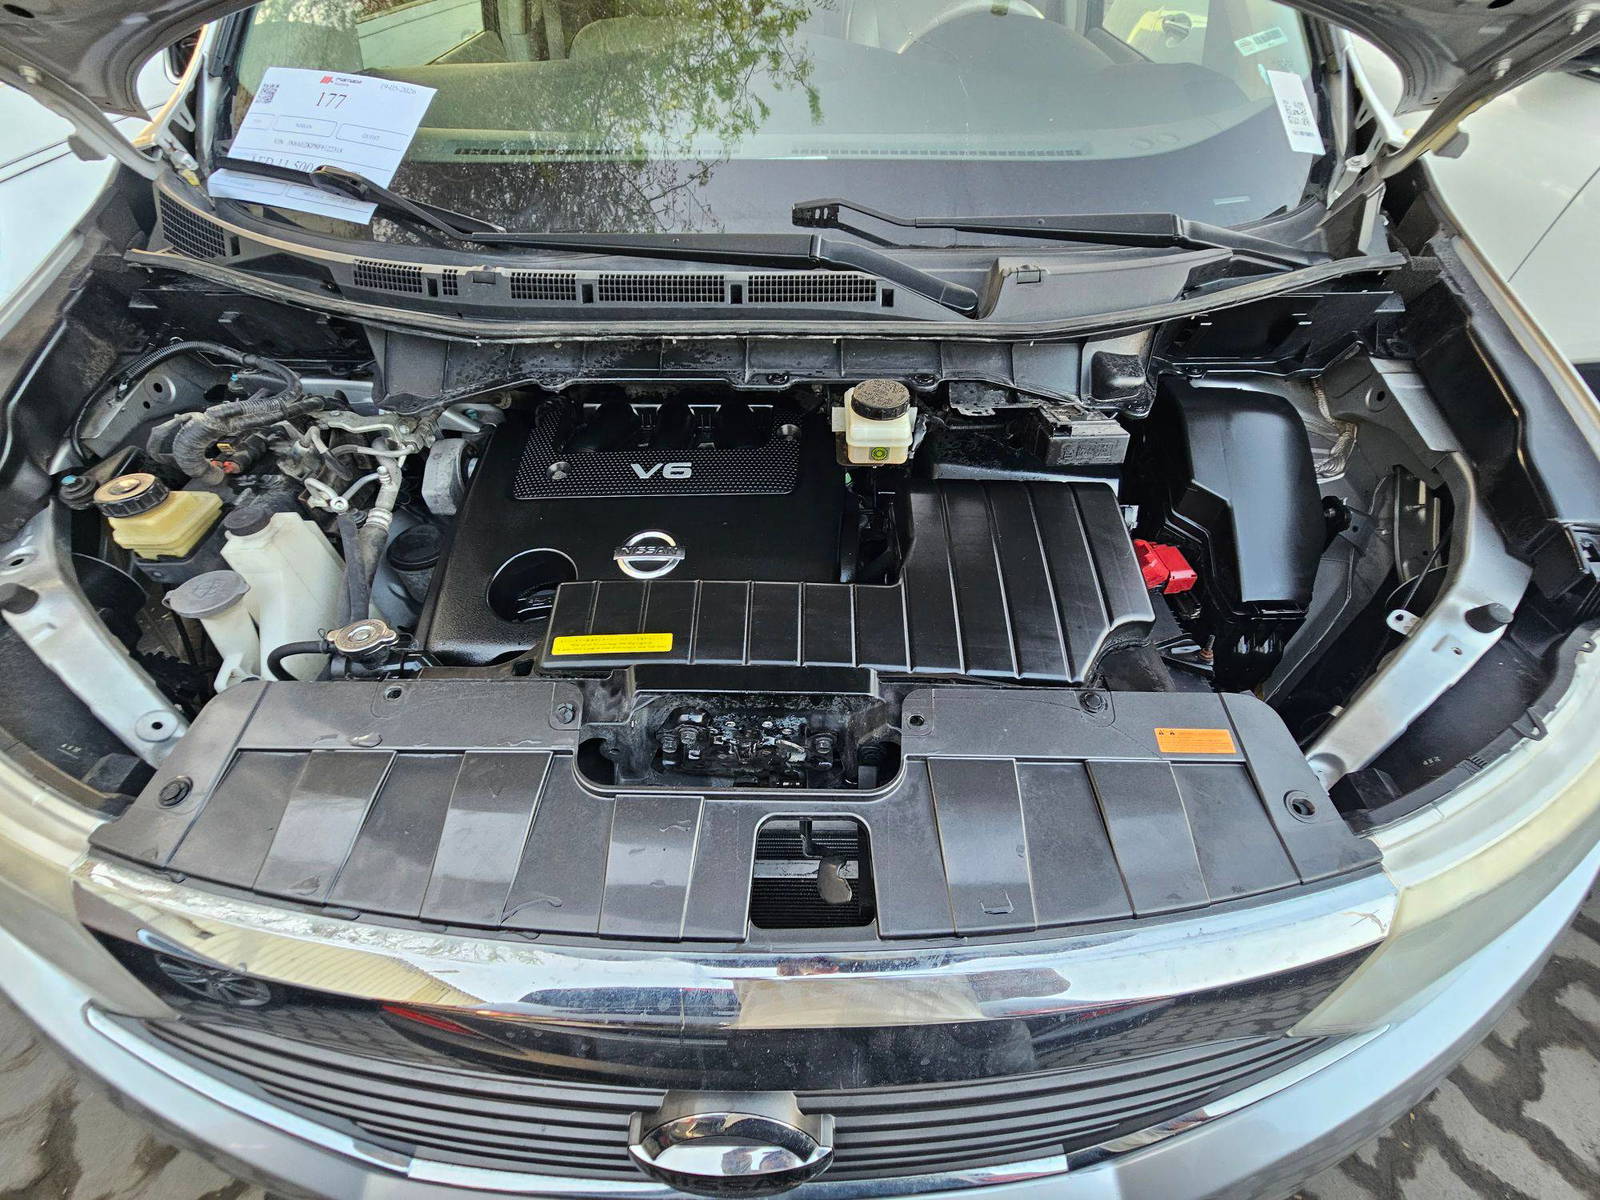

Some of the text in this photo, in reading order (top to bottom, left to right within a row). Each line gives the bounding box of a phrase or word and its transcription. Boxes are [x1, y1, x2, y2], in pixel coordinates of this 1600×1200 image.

[315, 91, 347, 110] 177
[630, 462, 693, 480] V6
[620, 545, 679, 556] NISSAN
